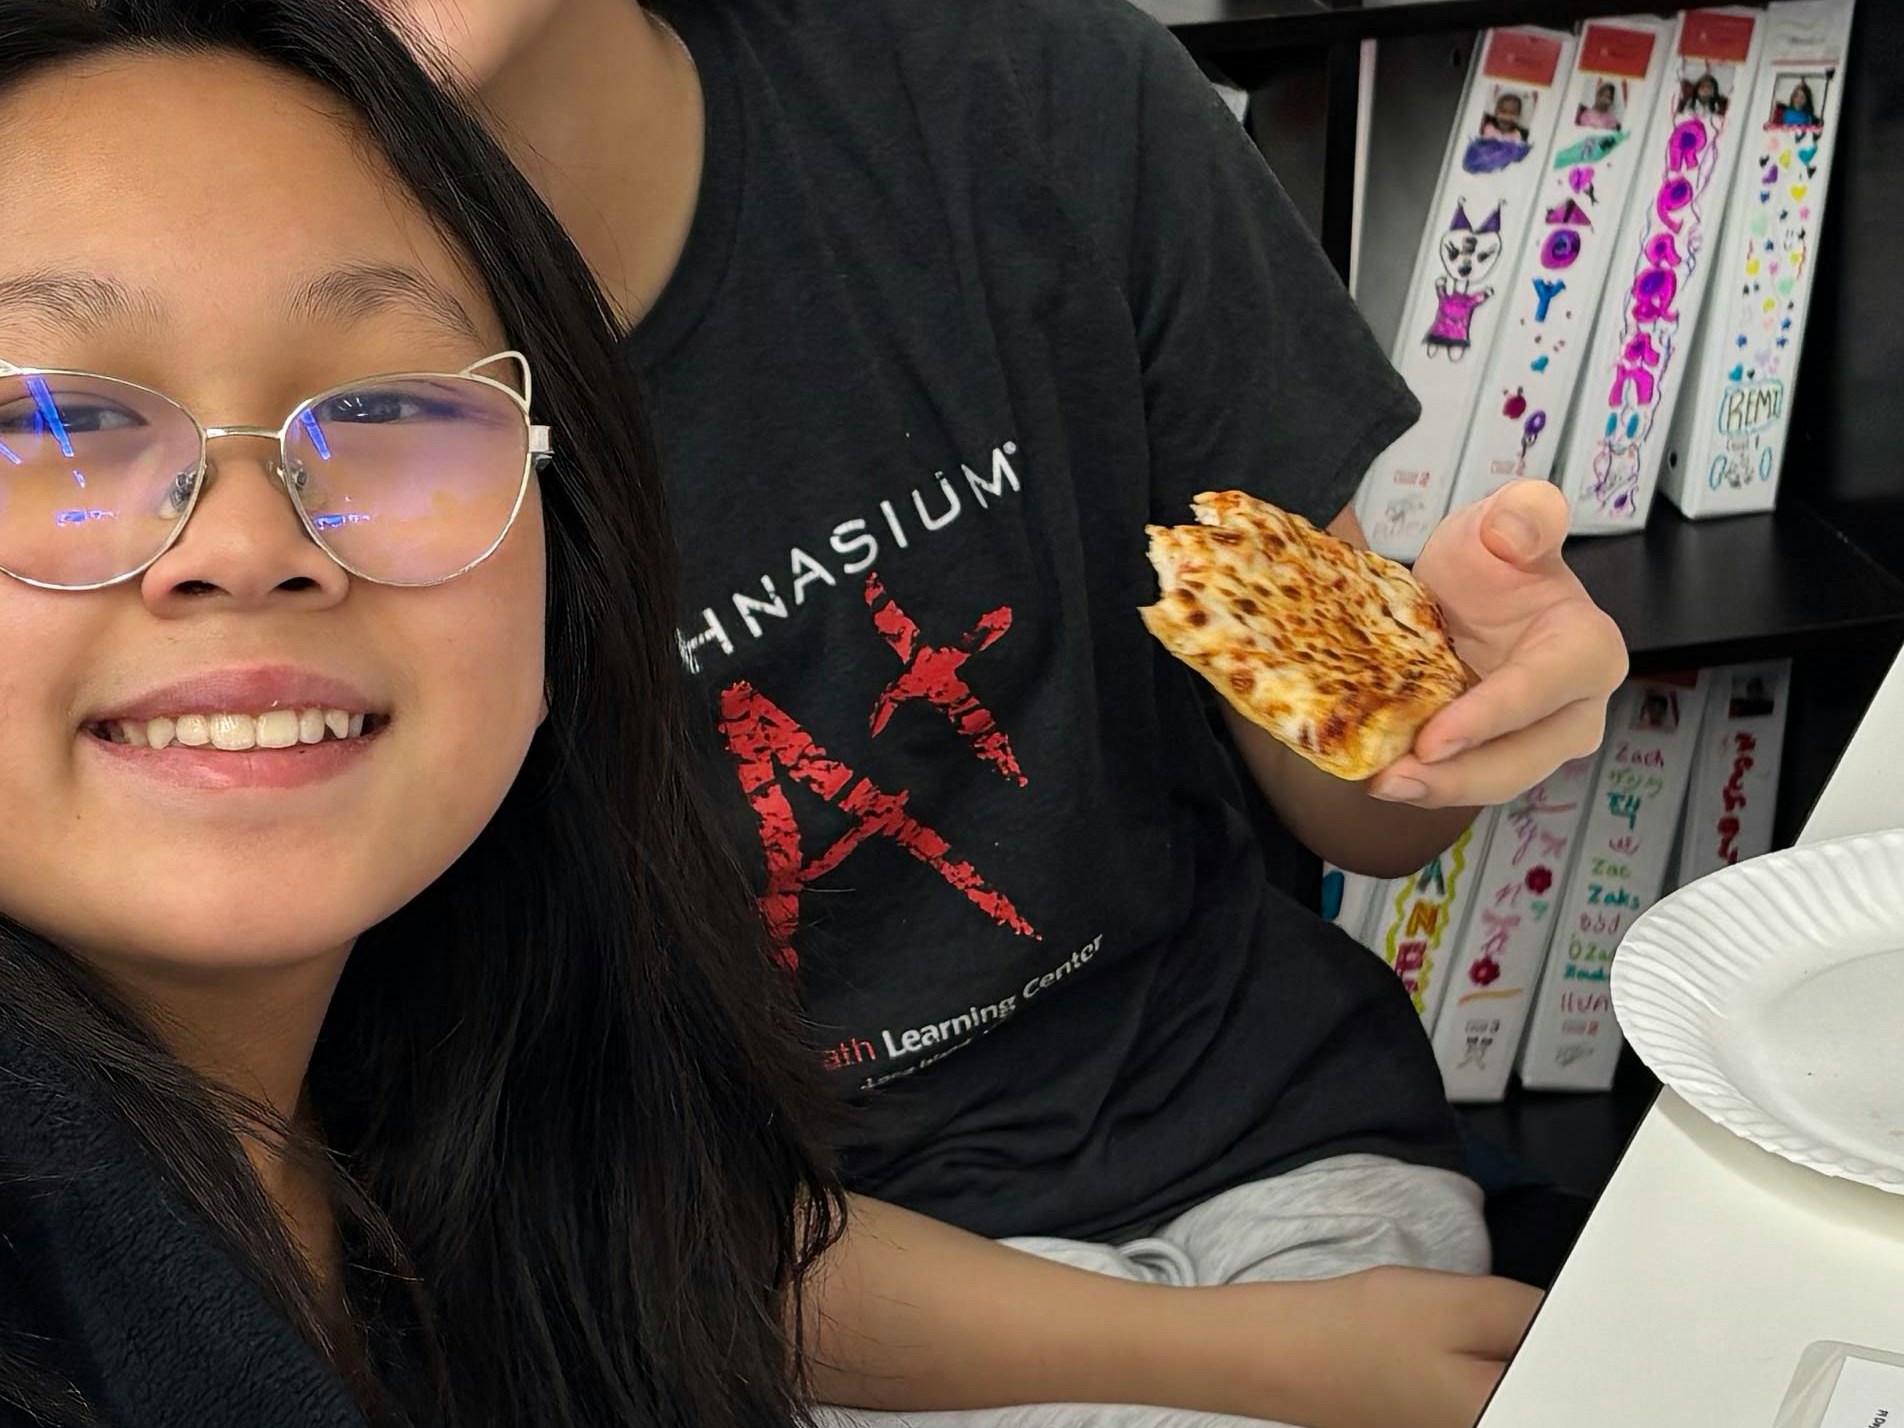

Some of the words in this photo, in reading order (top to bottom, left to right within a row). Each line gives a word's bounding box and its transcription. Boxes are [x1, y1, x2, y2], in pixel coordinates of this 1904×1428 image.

[1726, 386, 1781, 431] REMI
[677, 441, 1022, 674] HNASIUM
[820, 1035, 876, 1071] ath
[882, 990, 1017, 1059] Learning
